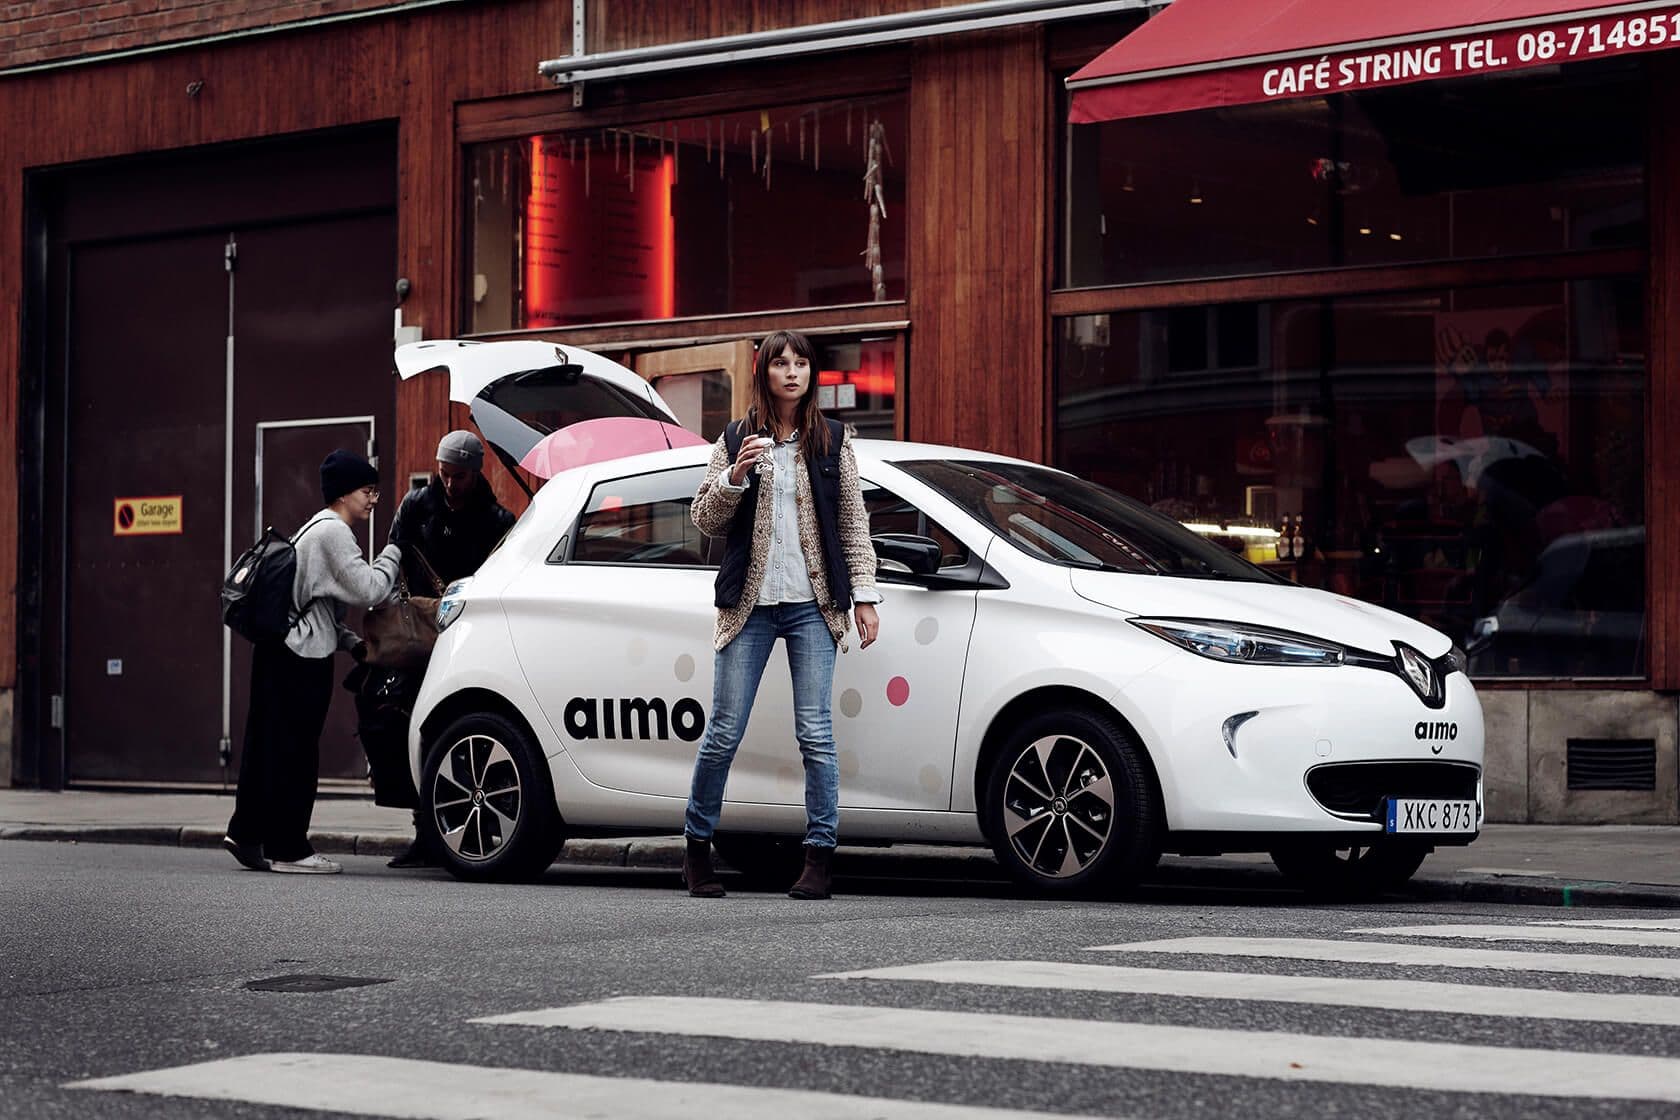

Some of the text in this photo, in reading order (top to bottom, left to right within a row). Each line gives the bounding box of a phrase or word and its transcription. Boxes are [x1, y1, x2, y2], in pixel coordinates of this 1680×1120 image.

[1262, 56, 1331, 96] CAFÉ
[1338, 47, 1442, 86] STRING
[1449, 40, 1507, 71] TEL.
[141, 502, 174, 519] Garage
[1404, 802, 1437, 829] XKC
[1442, 803, 1471, 829] 873
